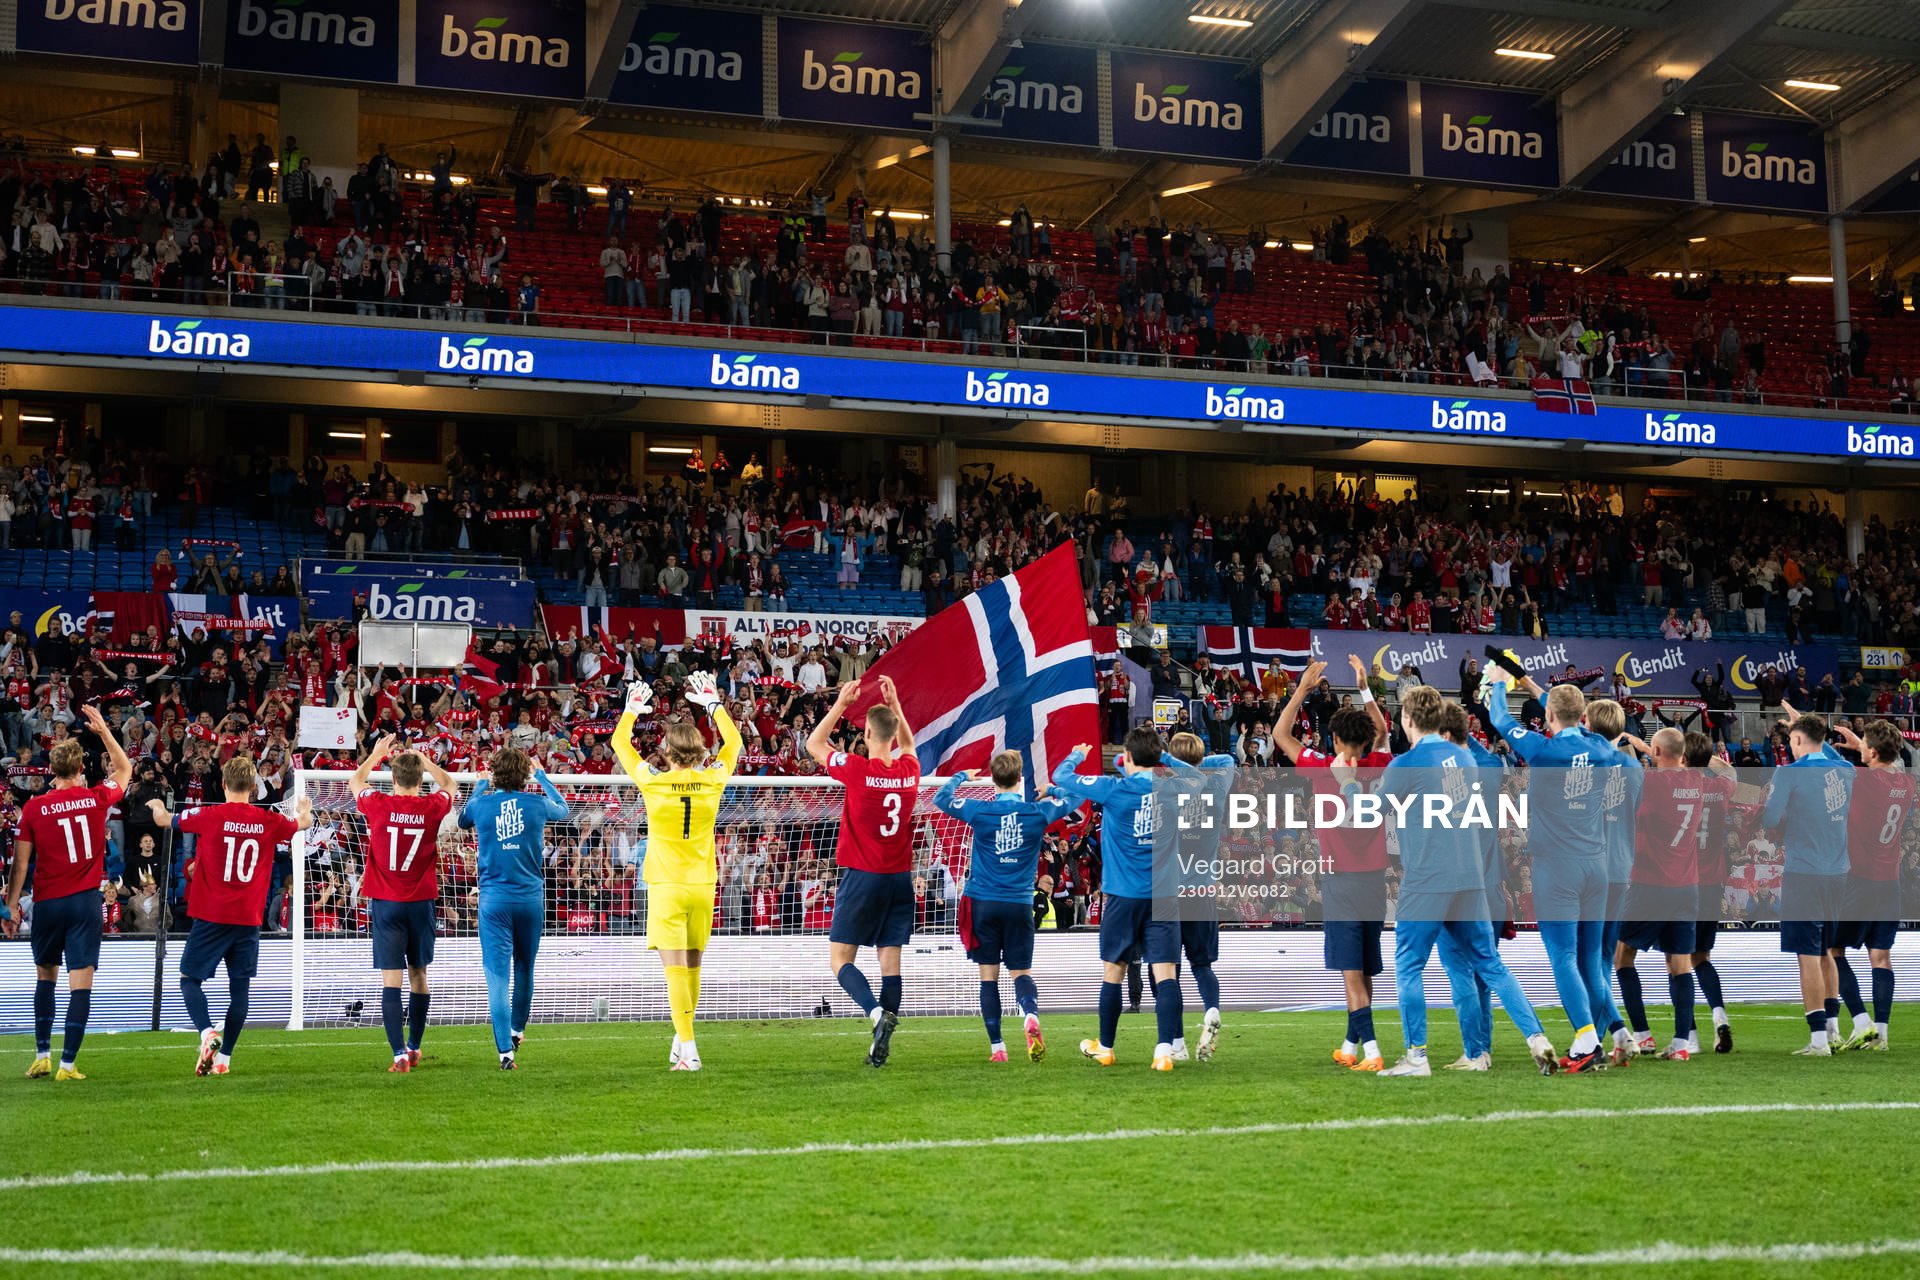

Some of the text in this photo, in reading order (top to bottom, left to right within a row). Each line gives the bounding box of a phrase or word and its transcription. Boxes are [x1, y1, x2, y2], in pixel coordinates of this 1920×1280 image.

[237, 0, 376, 48] bama
[441, 14, 570, 69] bama
[802, 49, 921, 100] bama
[985, 77, 1083, 115] ama
[1135, 82, 1244, 131] bama
[1308, 111, 1392, 144] ama
[1442, 113, 1544, 159] bama
[1618, 140, 1677, 171] ma
[1722, 140, 1817, 185] bama
[149, 320, 250, 358] bama
[438, 336, 535, 374] bama
[711, 354, 800, 390] bama
[966, 370, 1050, 407] bama
[1205, 387, 1284, 420] bama
[1432, 400, 1506, 433] bama
[1646, 413, 1717, 445] bama
[1847, 425, 1915, 457] bama
[252, 604, 286, 629] dit
[370, 583, 476, 622] bama
[216, 619, 268, 629] ALT FOR NORGE
[734, 617, 765, 633] ALT
[815, 620, 878, 636] NORGE
[1389, 639, 1448, 672] Bendit
[1630, 646, 1686, 679] Bendit
[1866, 654, 1886, 666] 231
[337, 735, 345, 745] 8
[738, 755, 768, 764] RGE
[1565, 764, 1594, 786] MOVE
[865, 776, 902, 789] VASSBAKK
[1563, 780, 1593, 800] SLEEP
[1672, 788, 1700, 799] AURSNES
[41, 798, 97, 816] O. SOLBAKKEN
[500, 798, 519, 815] EAT
[880, 793, 902, 837] 3
[1134, 803, 1163, 825] MOVE
[1141, 790, 1159, 809] EAT
[223, 821, 264, 834] ØDEGAARD
[390, 811, 425, 824] BJØRKAN
[495, 808, 524, 831] MOVE
[496, 823, 525, 841] SLEEP
[680, 796, 691, 839] 1
[995, 823, 1023, 844] MOVE
[1000, 811, 1019, 829] EAT
[1133, 819, 1163, 838] SLEEP
[1670, 803, 1695, 847] 7
[1879, 803, 1902, 844] 8
[57, 814, 94, 864] 11
[386, 825, 425, 872] 17
[995, 838, 1024, 855] SLEEP
[223, 836, 260, 883] 10
[571, 915, 595, 925] PHOT
